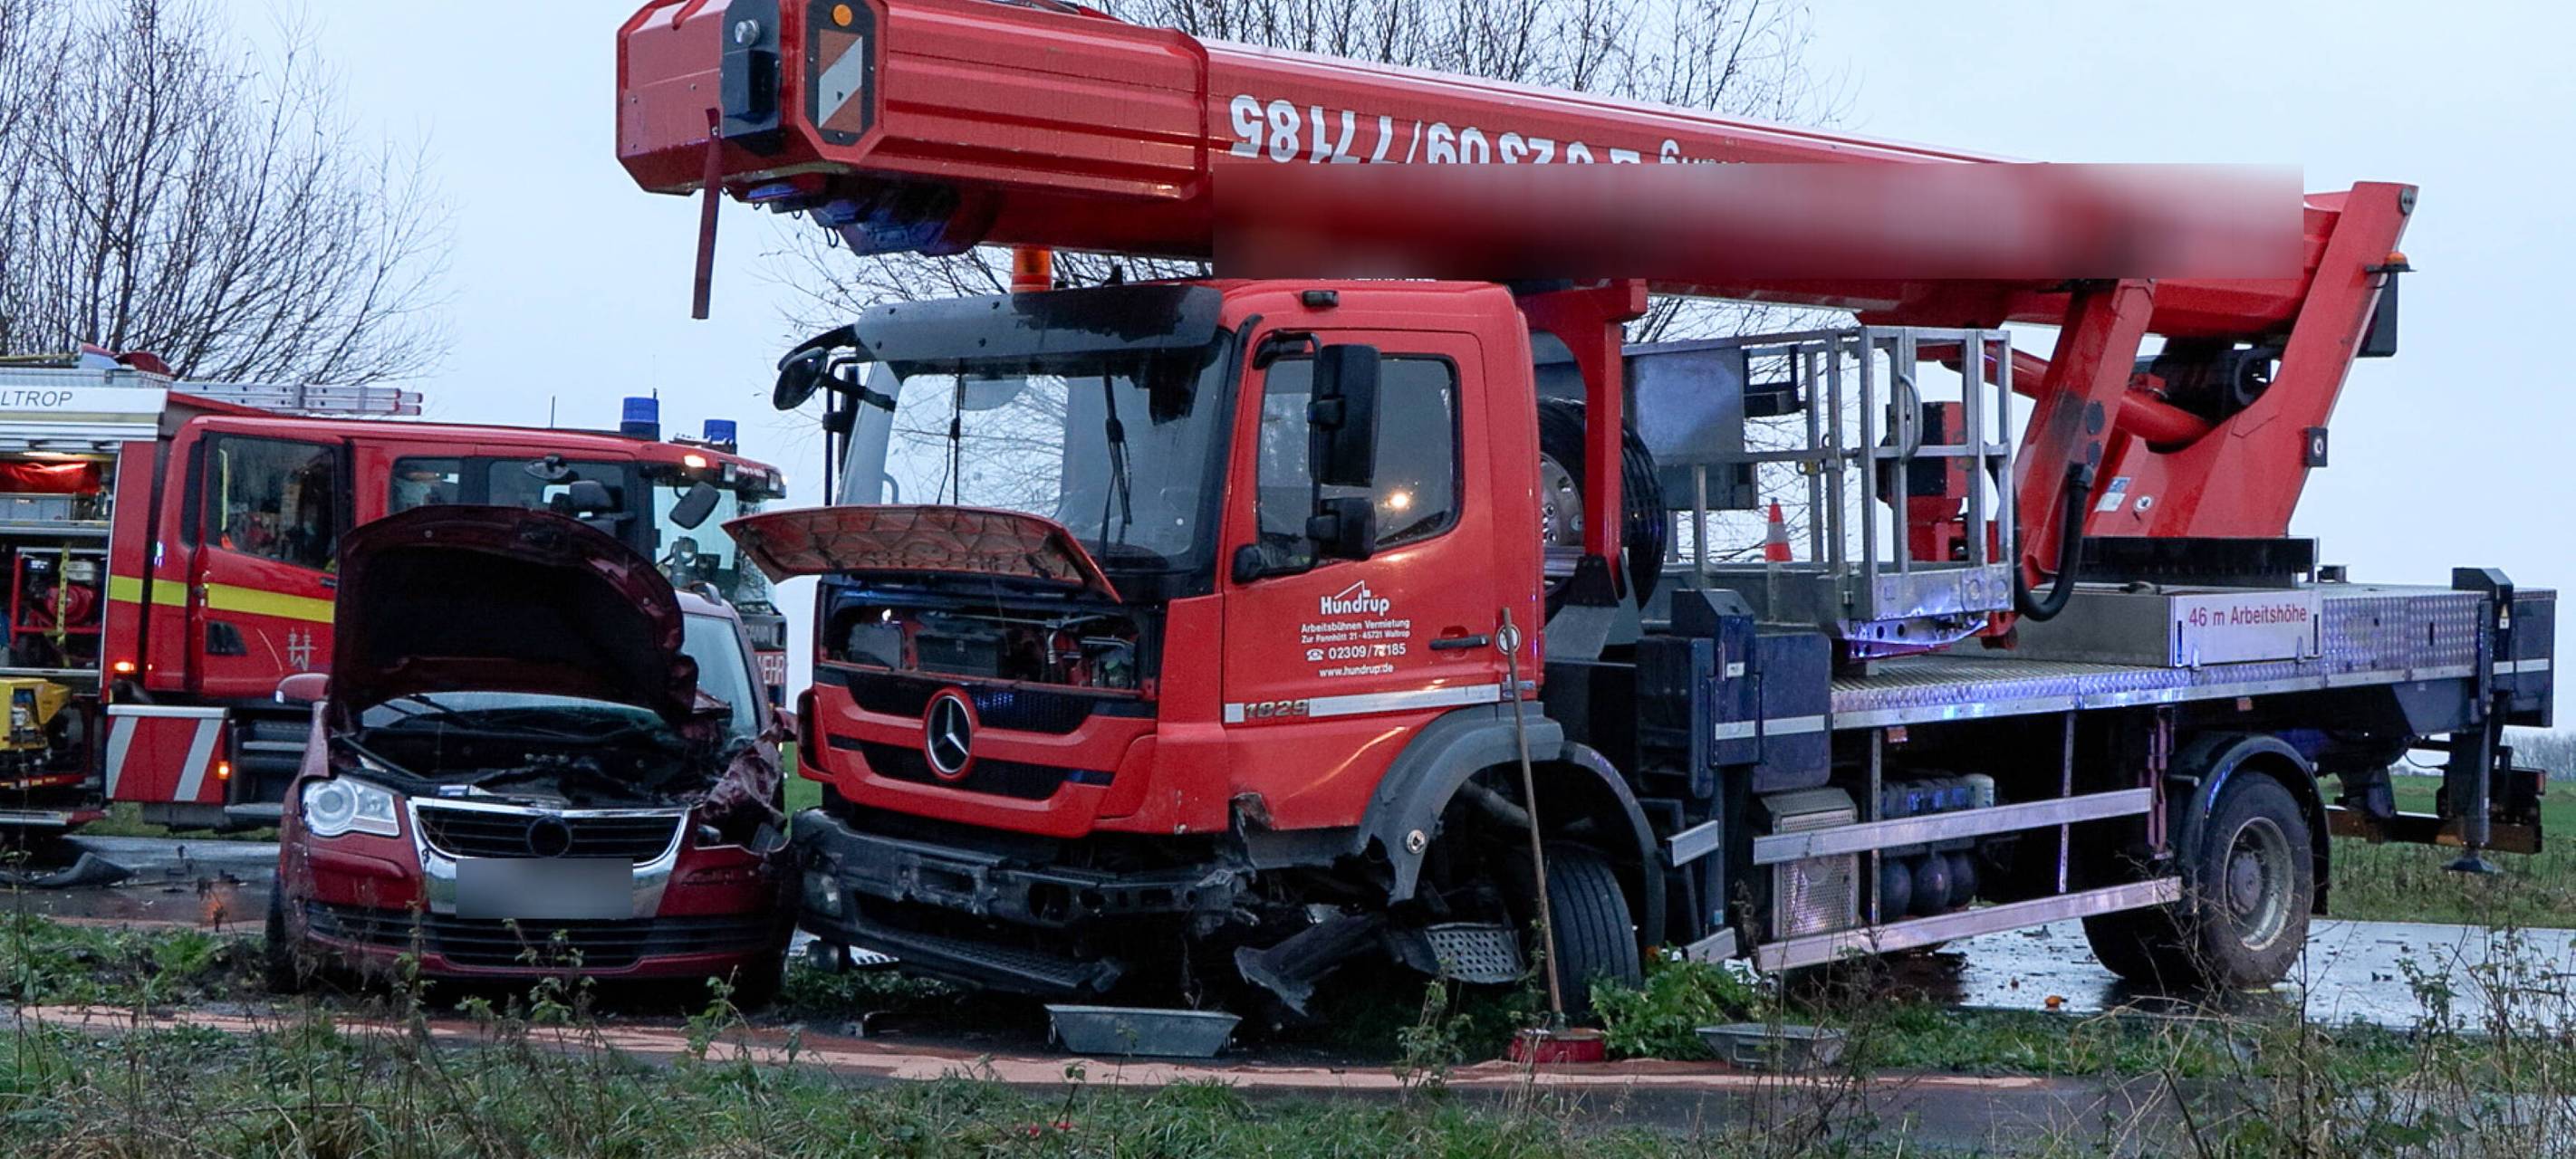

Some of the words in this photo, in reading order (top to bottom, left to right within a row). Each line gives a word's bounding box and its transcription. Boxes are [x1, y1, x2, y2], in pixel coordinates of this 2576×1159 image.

[1, 390, 73, 407] LTROP
[1320, 592, 1390, 617] Hundrup
[2188, 607, 2207, 627] 46
[2213, 610, 2225, 626] m
[2230, 604, 2308, 624] Arbeitshöhe
[1301, 622, 1362, 633] Arbeitsbühnen
[1364, 619, 1410, 629] Vermietung
[1301, 635, 1314, 644] Zur
[1319, 663, 1394, 676] www.hundrup.de
[1245, 699, 1310, 718] 1829
